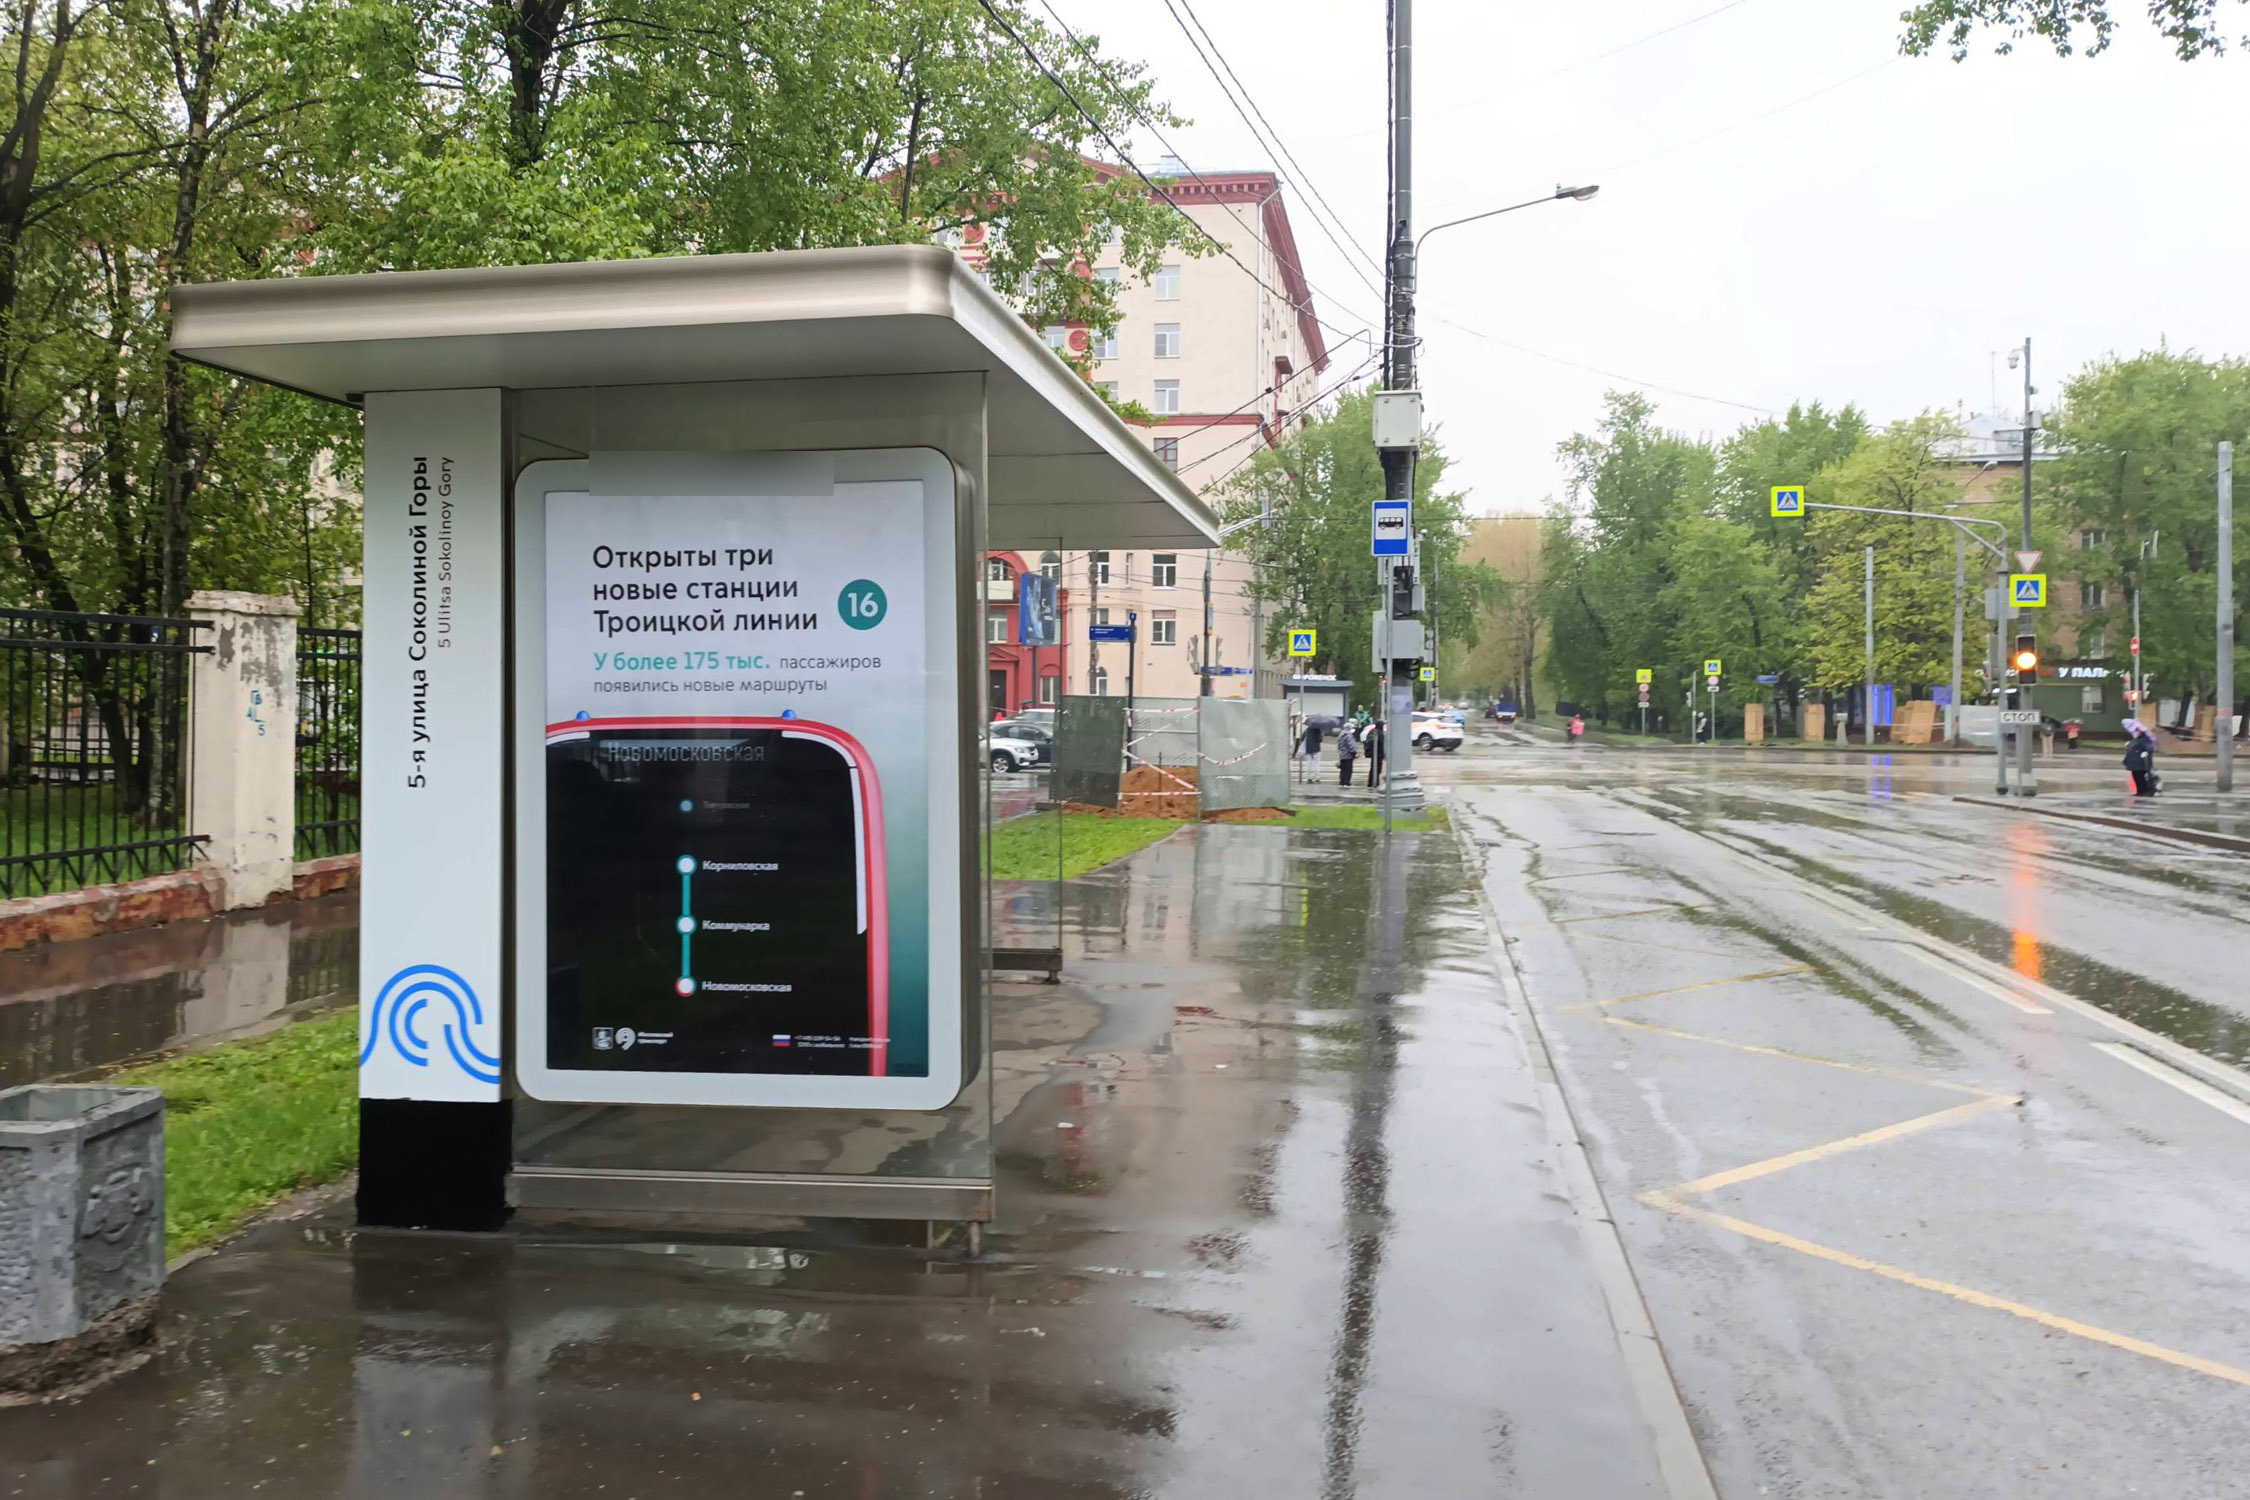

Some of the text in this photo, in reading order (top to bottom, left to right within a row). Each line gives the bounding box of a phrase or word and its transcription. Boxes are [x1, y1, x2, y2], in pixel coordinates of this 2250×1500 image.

[438, 457, 454, 648] 5 Ulitsa Sokolinoy Gory
[593, 545, 773, 573] Открыты три
[593, 580, 798, 601] новые станции
[847, 592, 879, 618] 16
[408, 457, 431, 788] 5-я улица Соколиной Горы
[593, 609, 817, 638] Троицкой линии
[593, 651, 882, 671] У более 175 тыс. пассажиров
[593, 677, 828, 695] появились новые маршруты
[2003, 712, 2035, 722] СТОП
[702, 919, 771, 932] Коммунарка
[701, 980, 793, 992] Новомосковская
